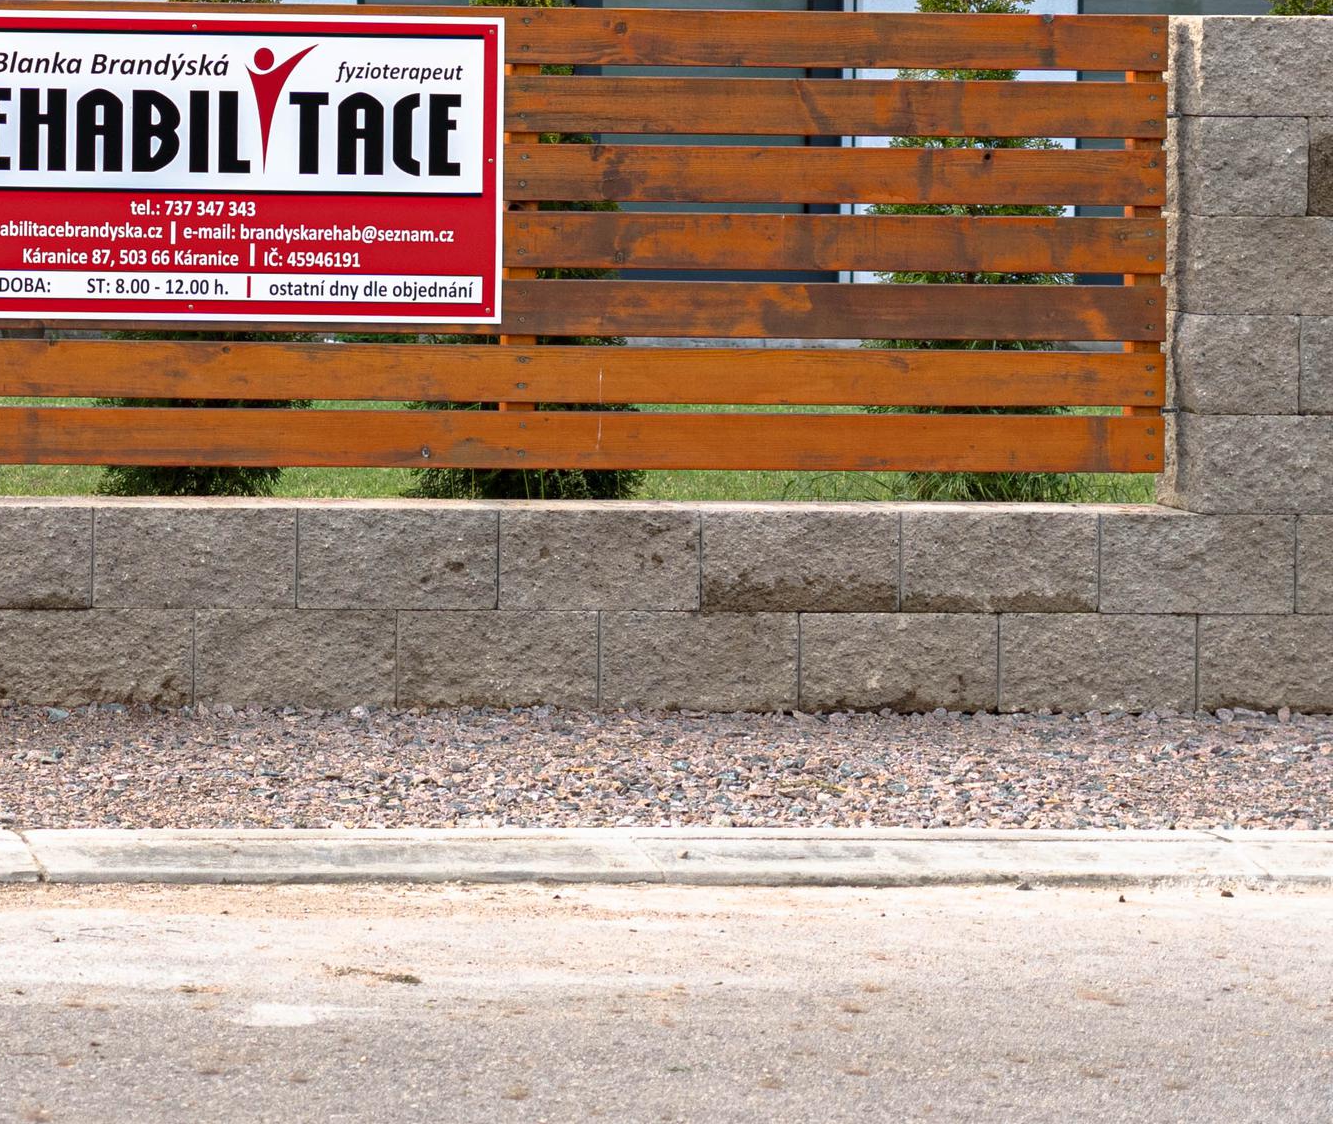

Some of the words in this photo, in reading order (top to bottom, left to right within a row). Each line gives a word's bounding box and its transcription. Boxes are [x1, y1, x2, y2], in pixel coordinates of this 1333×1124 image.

[90, 52, 230, 81] Brandýská
[335, 61, 463, 84] fyzioterapeut
[130, 199, 161, 216] tel.:
[164, 200, 193, 216] 737
[196, 201, 227, 217] 347
[228, 201, 256, 217] 343
[183, 223, 236, 240] e-mail:
[240, 224, 454, 245] brandyskarehab@seznam.cz
[22, 247, 88, 265] Káranice
[91, 249, 115, 268] 87,
[119, 250, 148, 266] 503
[151, 250, 170, 266] 66
[174, 249, 239, 267] Káranice
[263, 247, 283, 267] IČ:
[286, 251, 361, 268] 45946191
[86, 278, 110, 295] ST:
[115, 279, 150, 295] 8.00
[165, 279, 210, 295] 12.00
[214, 279, 229, 295] h.
[269, 280, 325, 297] ostatní
[329, 280, 359, 301] dny
[363, 280, 388, 298] dle
[392, 281, 473, 302] objednání
